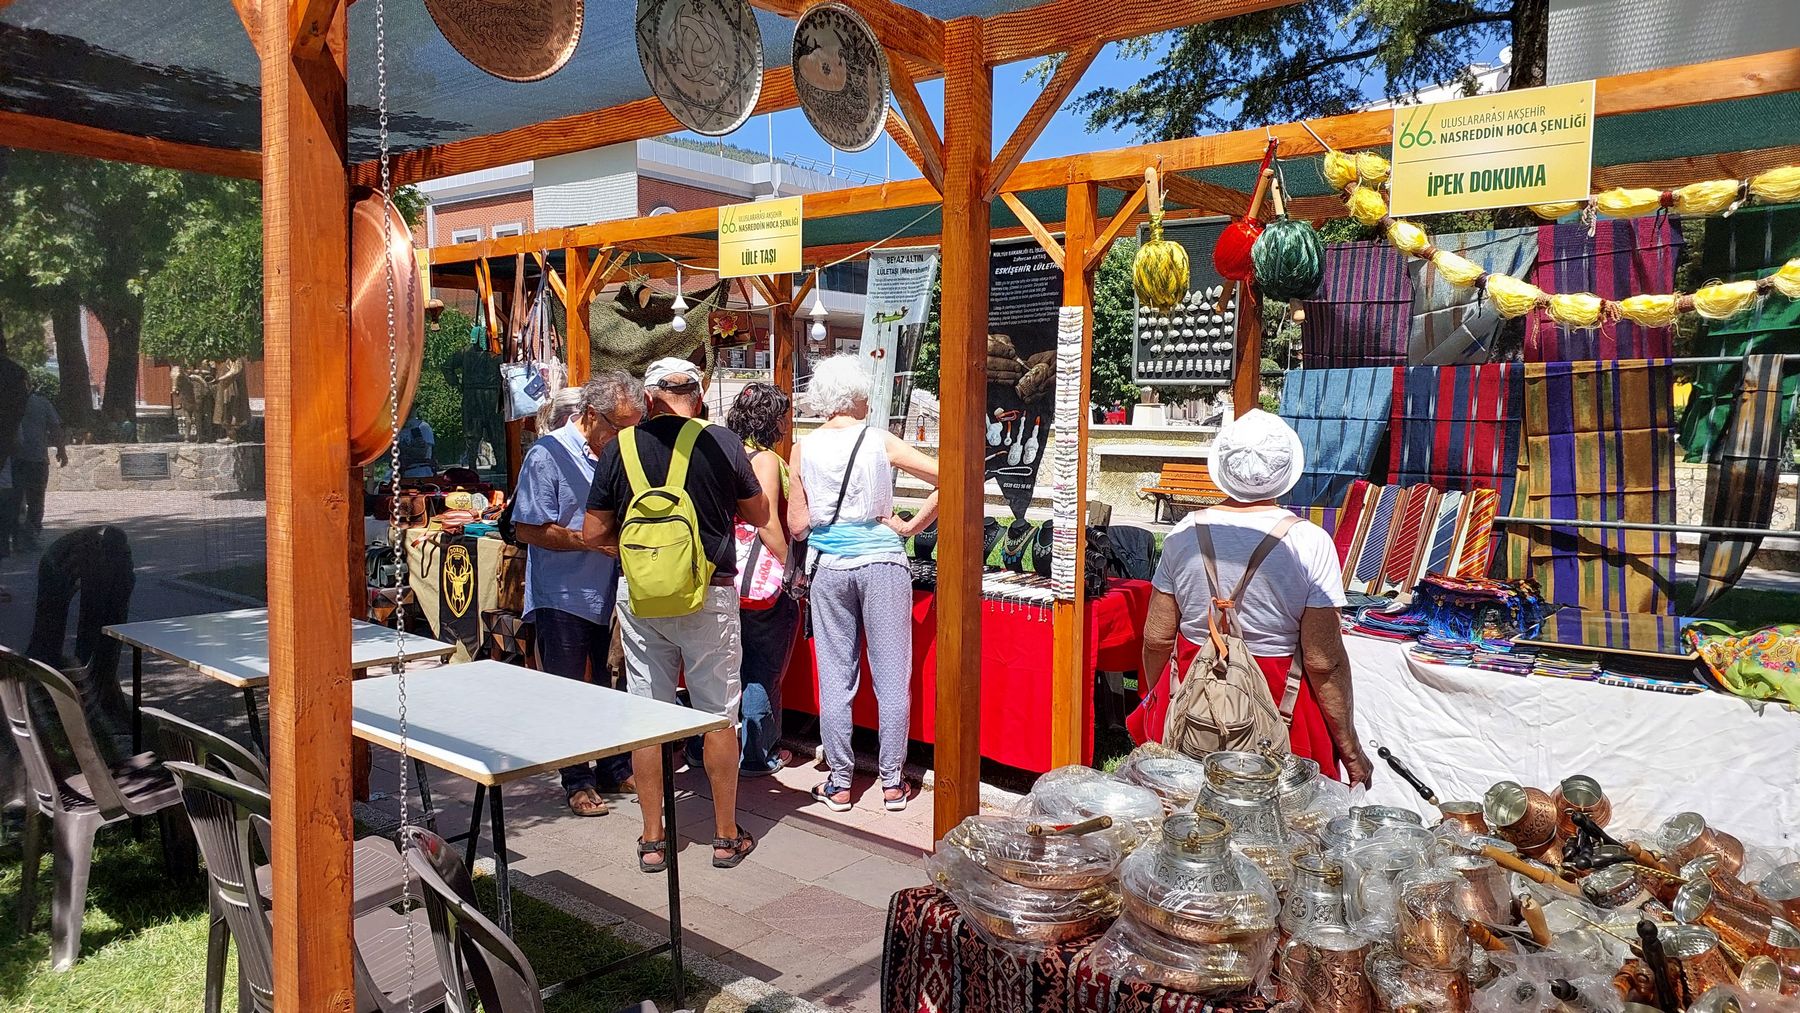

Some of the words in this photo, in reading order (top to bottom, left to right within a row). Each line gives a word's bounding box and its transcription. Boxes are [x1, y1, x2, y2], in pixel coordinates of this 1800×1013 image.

[1440, 111, 1505, 129] ULUSLARARASI
[1506, 105, 1546, 123] AKŞEHİR
[1440, 126, 1504, 144] NASREDDİN
[1506, 122, 1537, 136] HOCA
[1540, 113, 1587, 135] ŞENLİĞİ
[1427, 171, 1464, 197] İPEK
[1469, 164, 1546, 193] DOKUMA
[738, 221, 766, 232] NASREDDİN
[766, 219, 779, 229] HOCA
[780, 217, 799, 229] ŞENLİĞİ
[741, 249, 758, 265] LÜLE
[760, 248, 776, 265] TAŞI
[886, 255, 904, 264] BEYAZ
[906, 254, 924, 262] ALTIN
[995, 264, 1031, 275] ESKİŞEHİR
